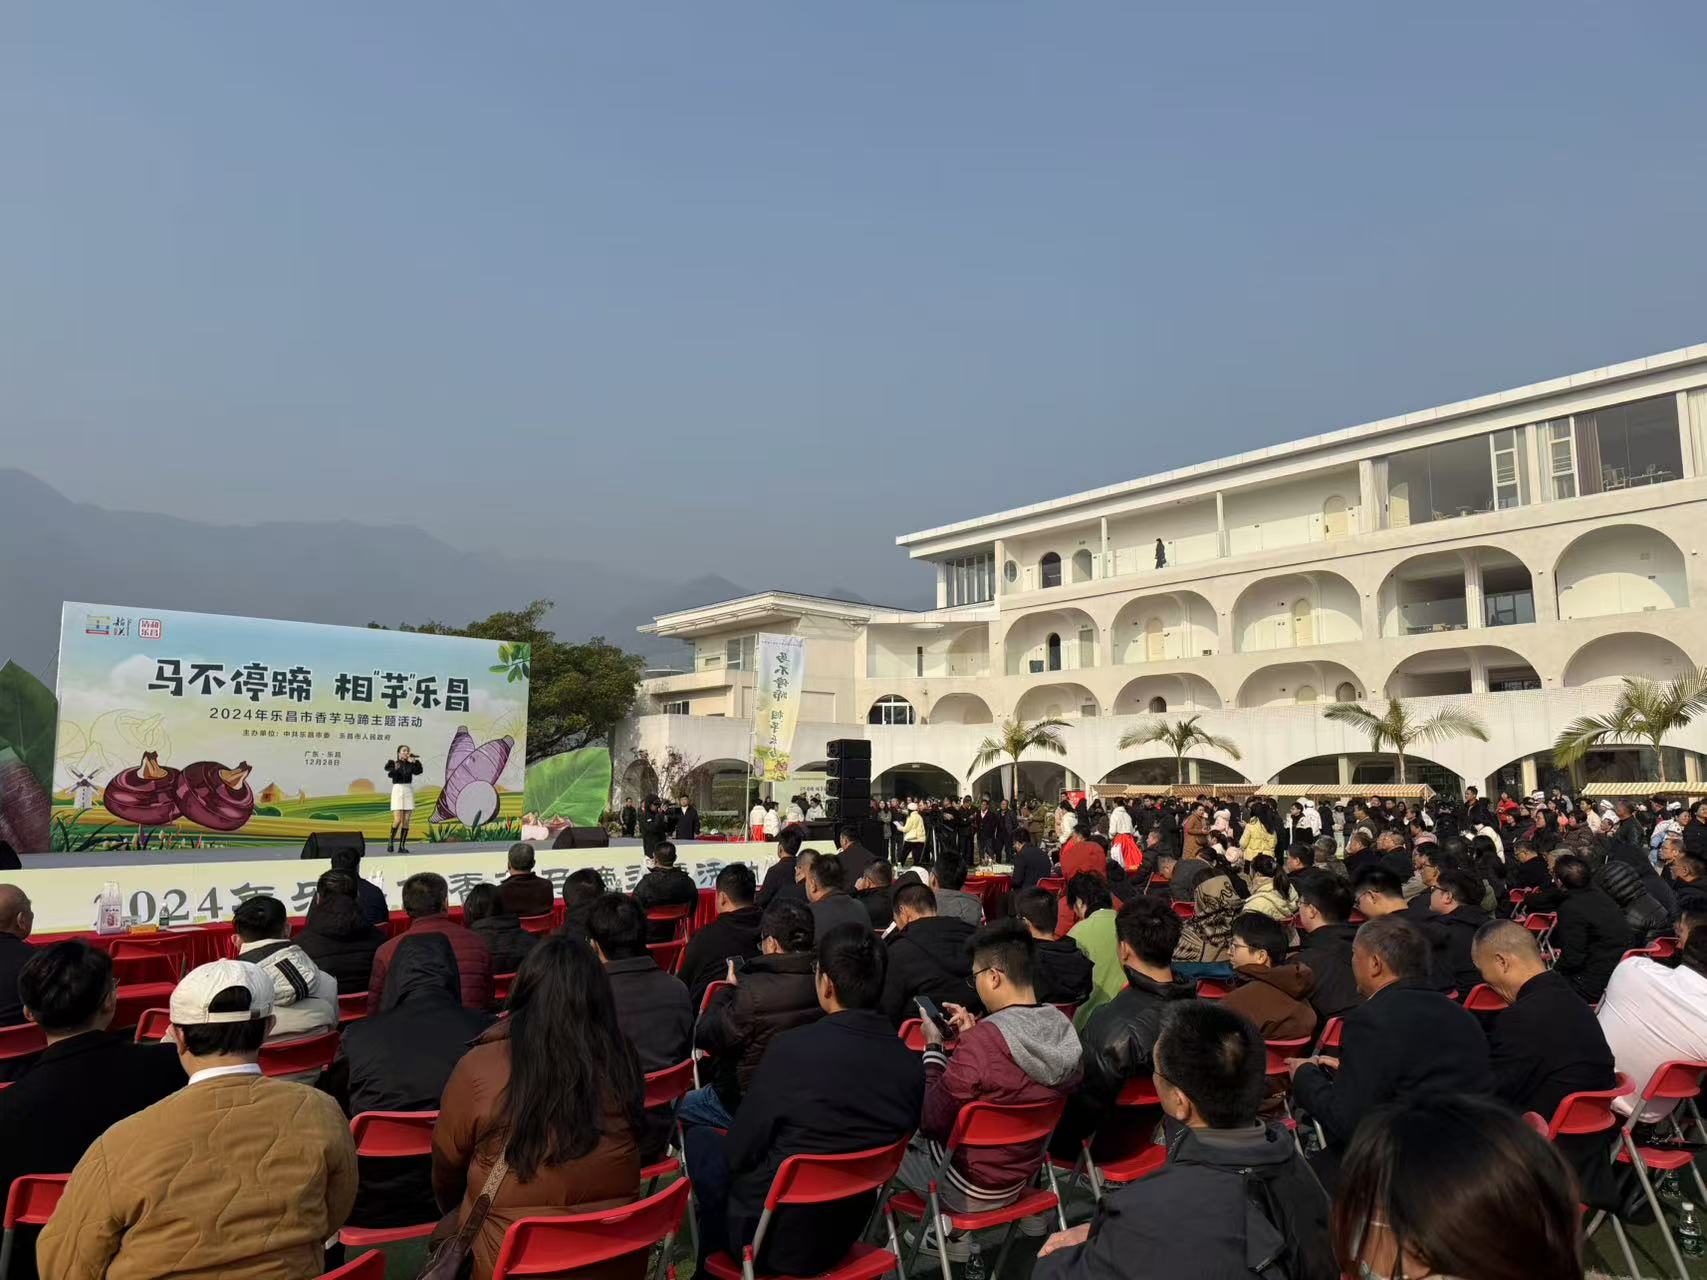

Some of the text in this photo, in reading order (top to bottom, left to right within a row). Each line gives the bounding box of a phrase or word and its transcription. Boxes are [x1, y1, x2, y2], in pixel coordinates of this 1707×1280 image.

[148, 659, 312, 702] 马不停蹄
[209, 707, 423, 728] 2024年乐昌市香芋马蹄主题活动
